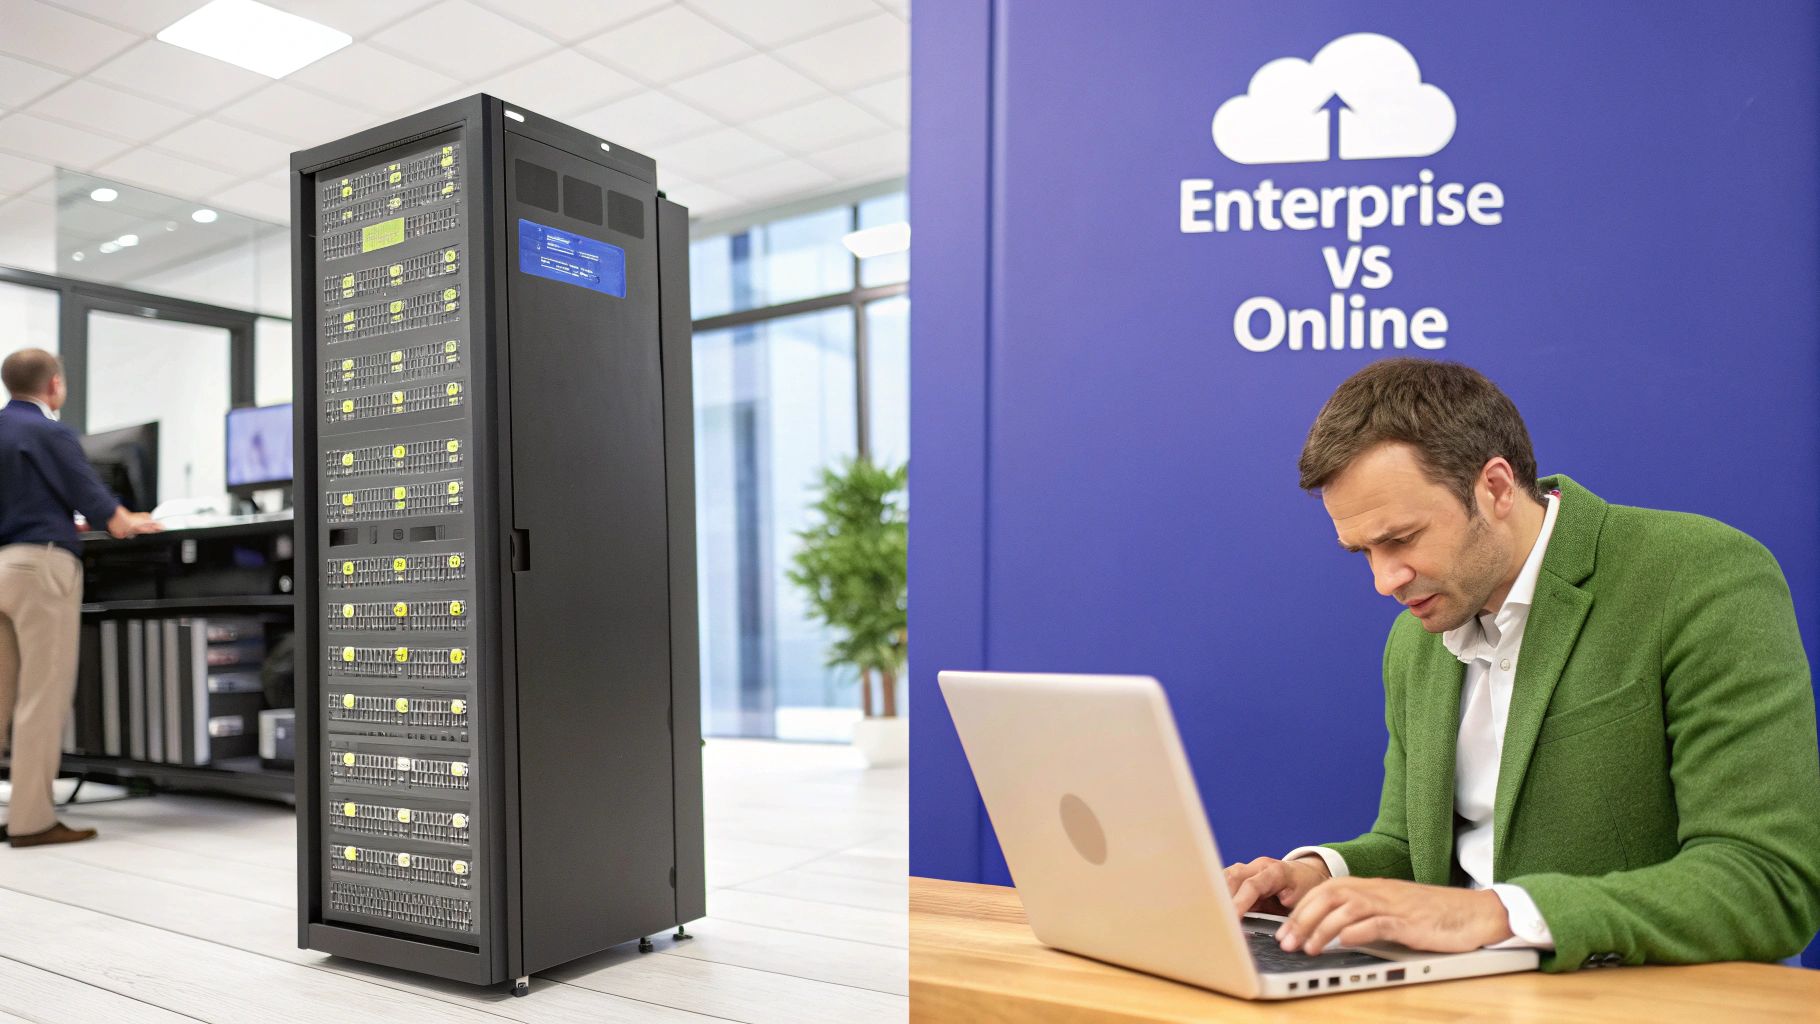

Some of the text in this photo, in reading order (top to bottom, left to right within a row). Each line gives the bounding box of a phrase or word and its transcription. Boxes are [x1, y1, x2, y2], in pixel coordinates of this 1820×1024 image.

[1180, 169, 1504, 242] Enterprise
[1322, 245, 1393, 289] vs
[1234, 293, 1448, 352] Online
